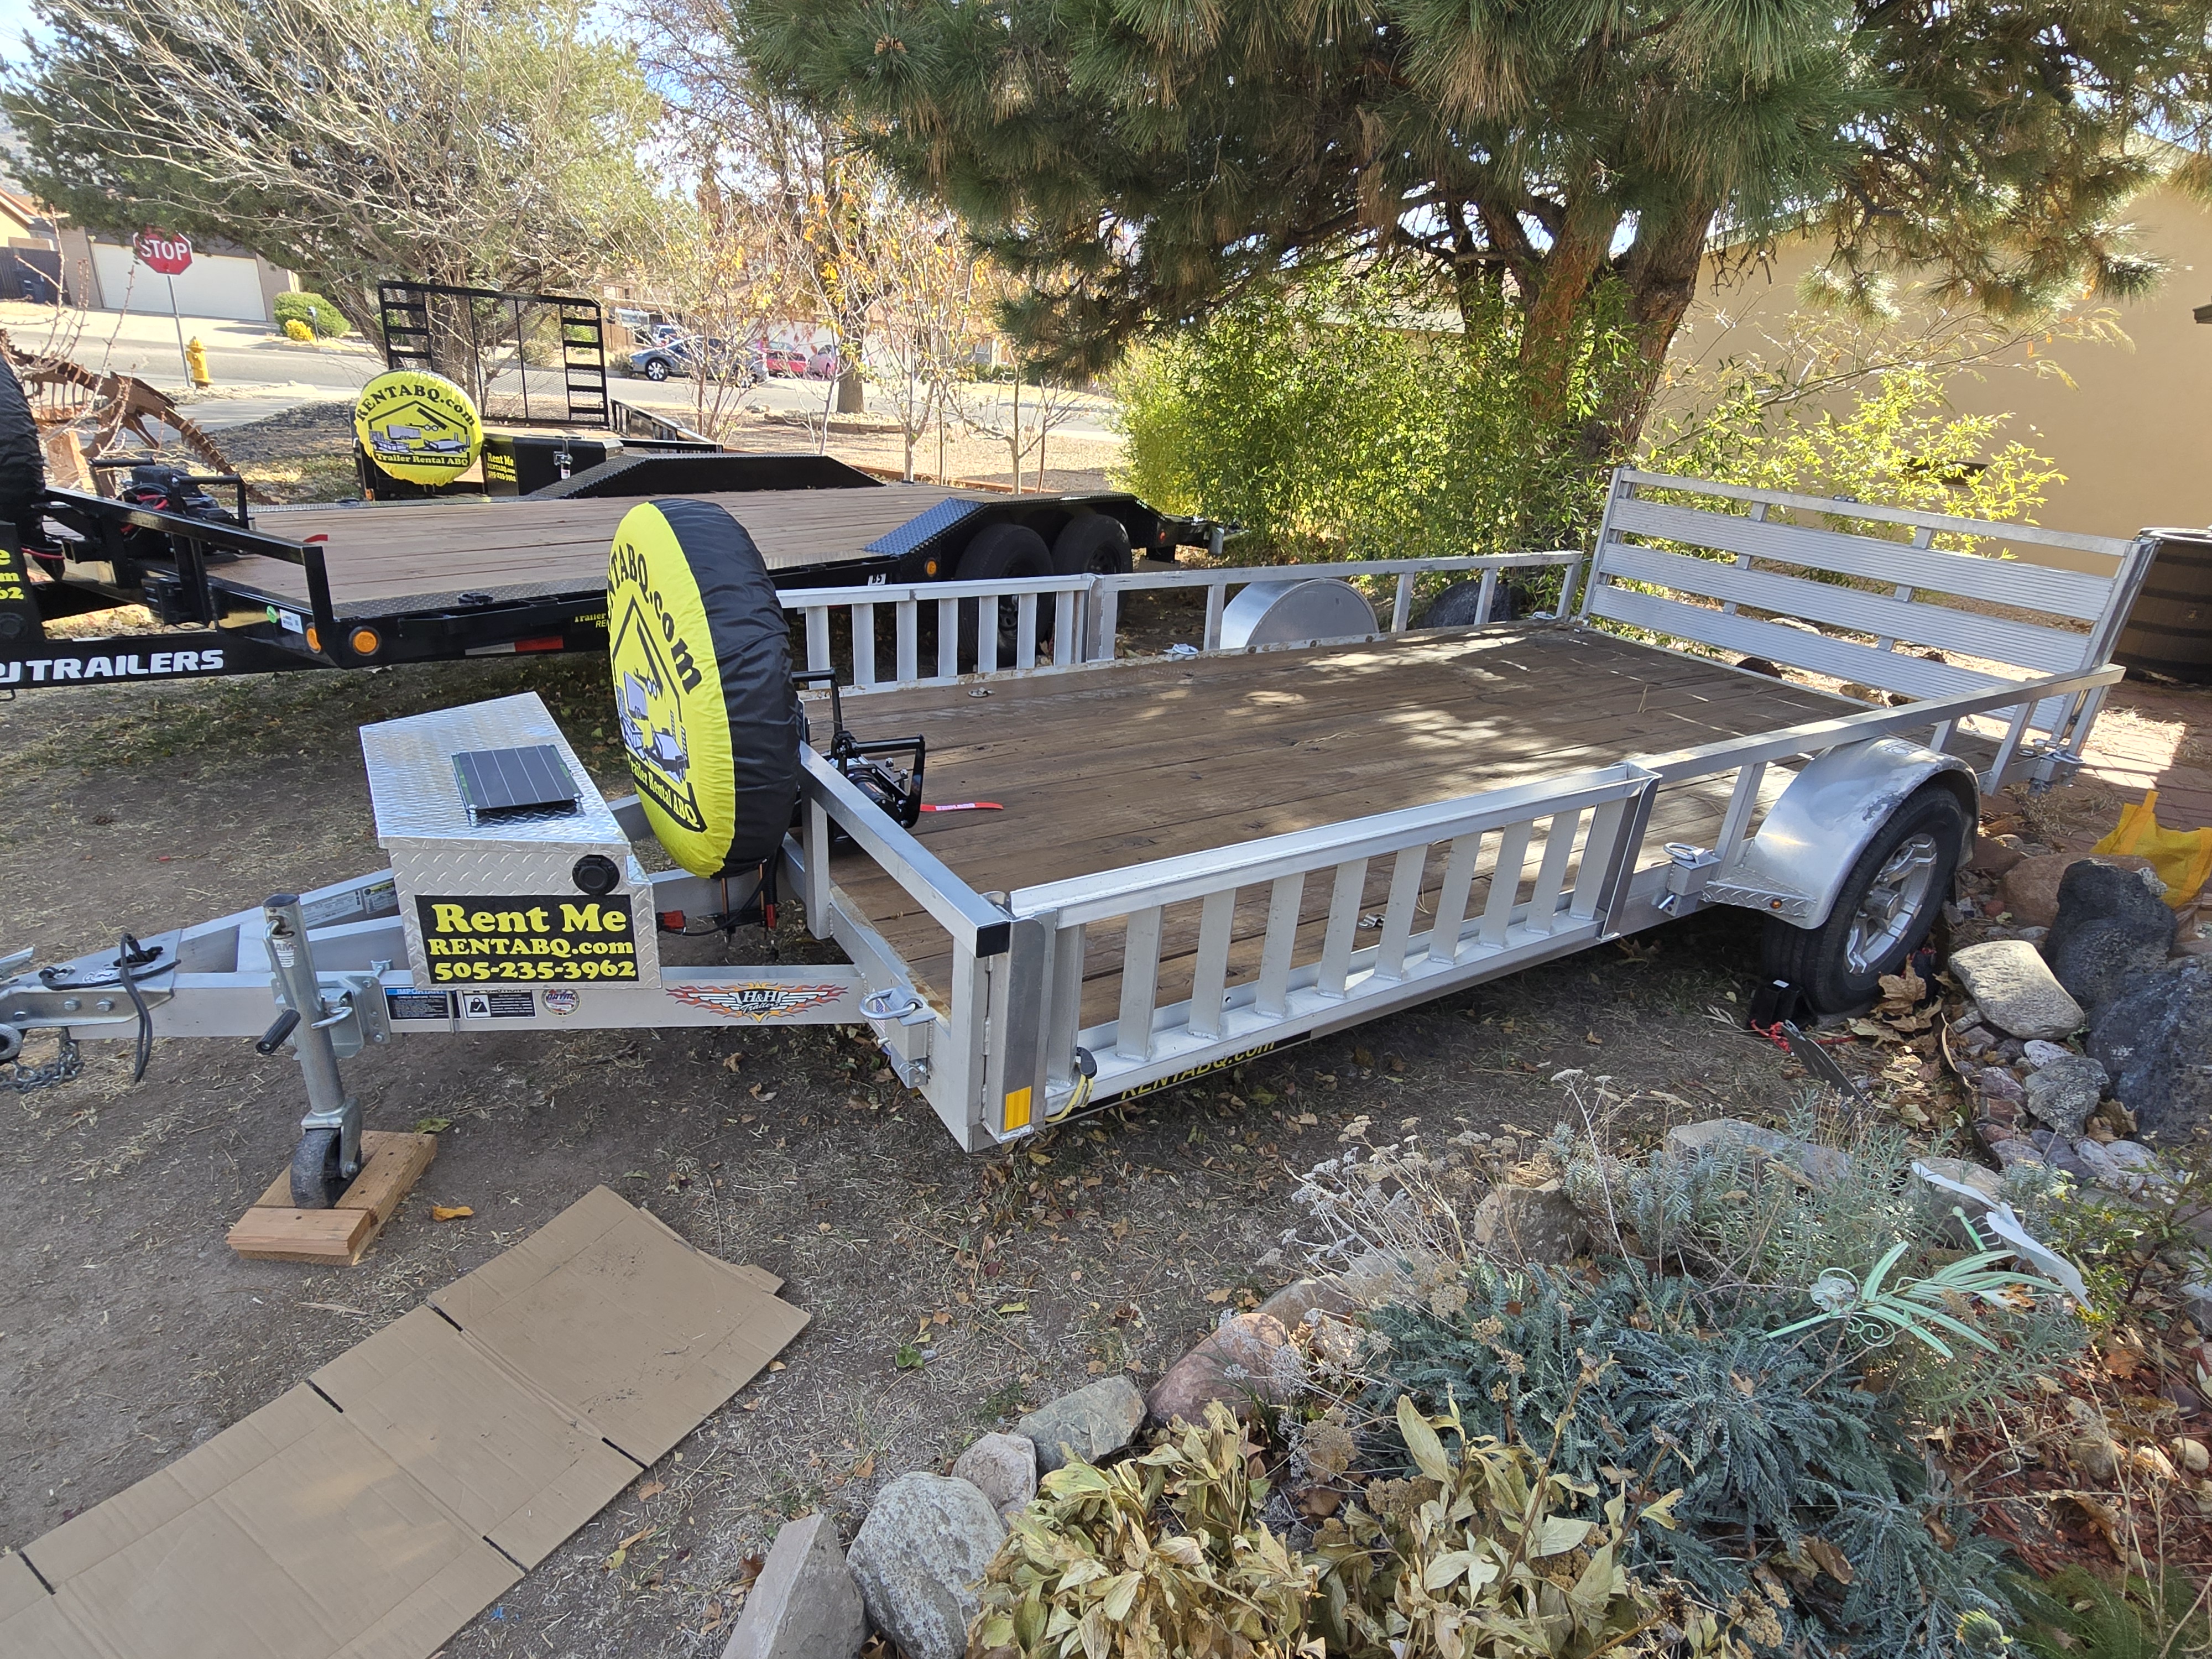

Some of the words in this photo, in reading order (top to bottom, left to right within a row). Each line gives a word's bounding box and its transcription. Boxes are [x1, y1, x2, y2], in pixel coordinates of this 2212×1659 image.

[140, 239, 187, 260] STOP
[356, 385, 476, 426] RENTABQ.com
[375, 453, 411, 462] Trailer
[413, 455, 445, 464] Rental
[447, 458, 468, 466] ABQ
[25, 649, 224, 681] TRAILERS
[648, 771, 672, 808] Rental
[673, 794, 701, 828] ABQ
[431, 904, 550, 933] Rent
[559, 903, 627, 932] Me
[428, 938, 634, 958] RENTABQ.com
[434, 959, 636, 980] 505-235-3962
[742, 990, 779, 1002] H&H
